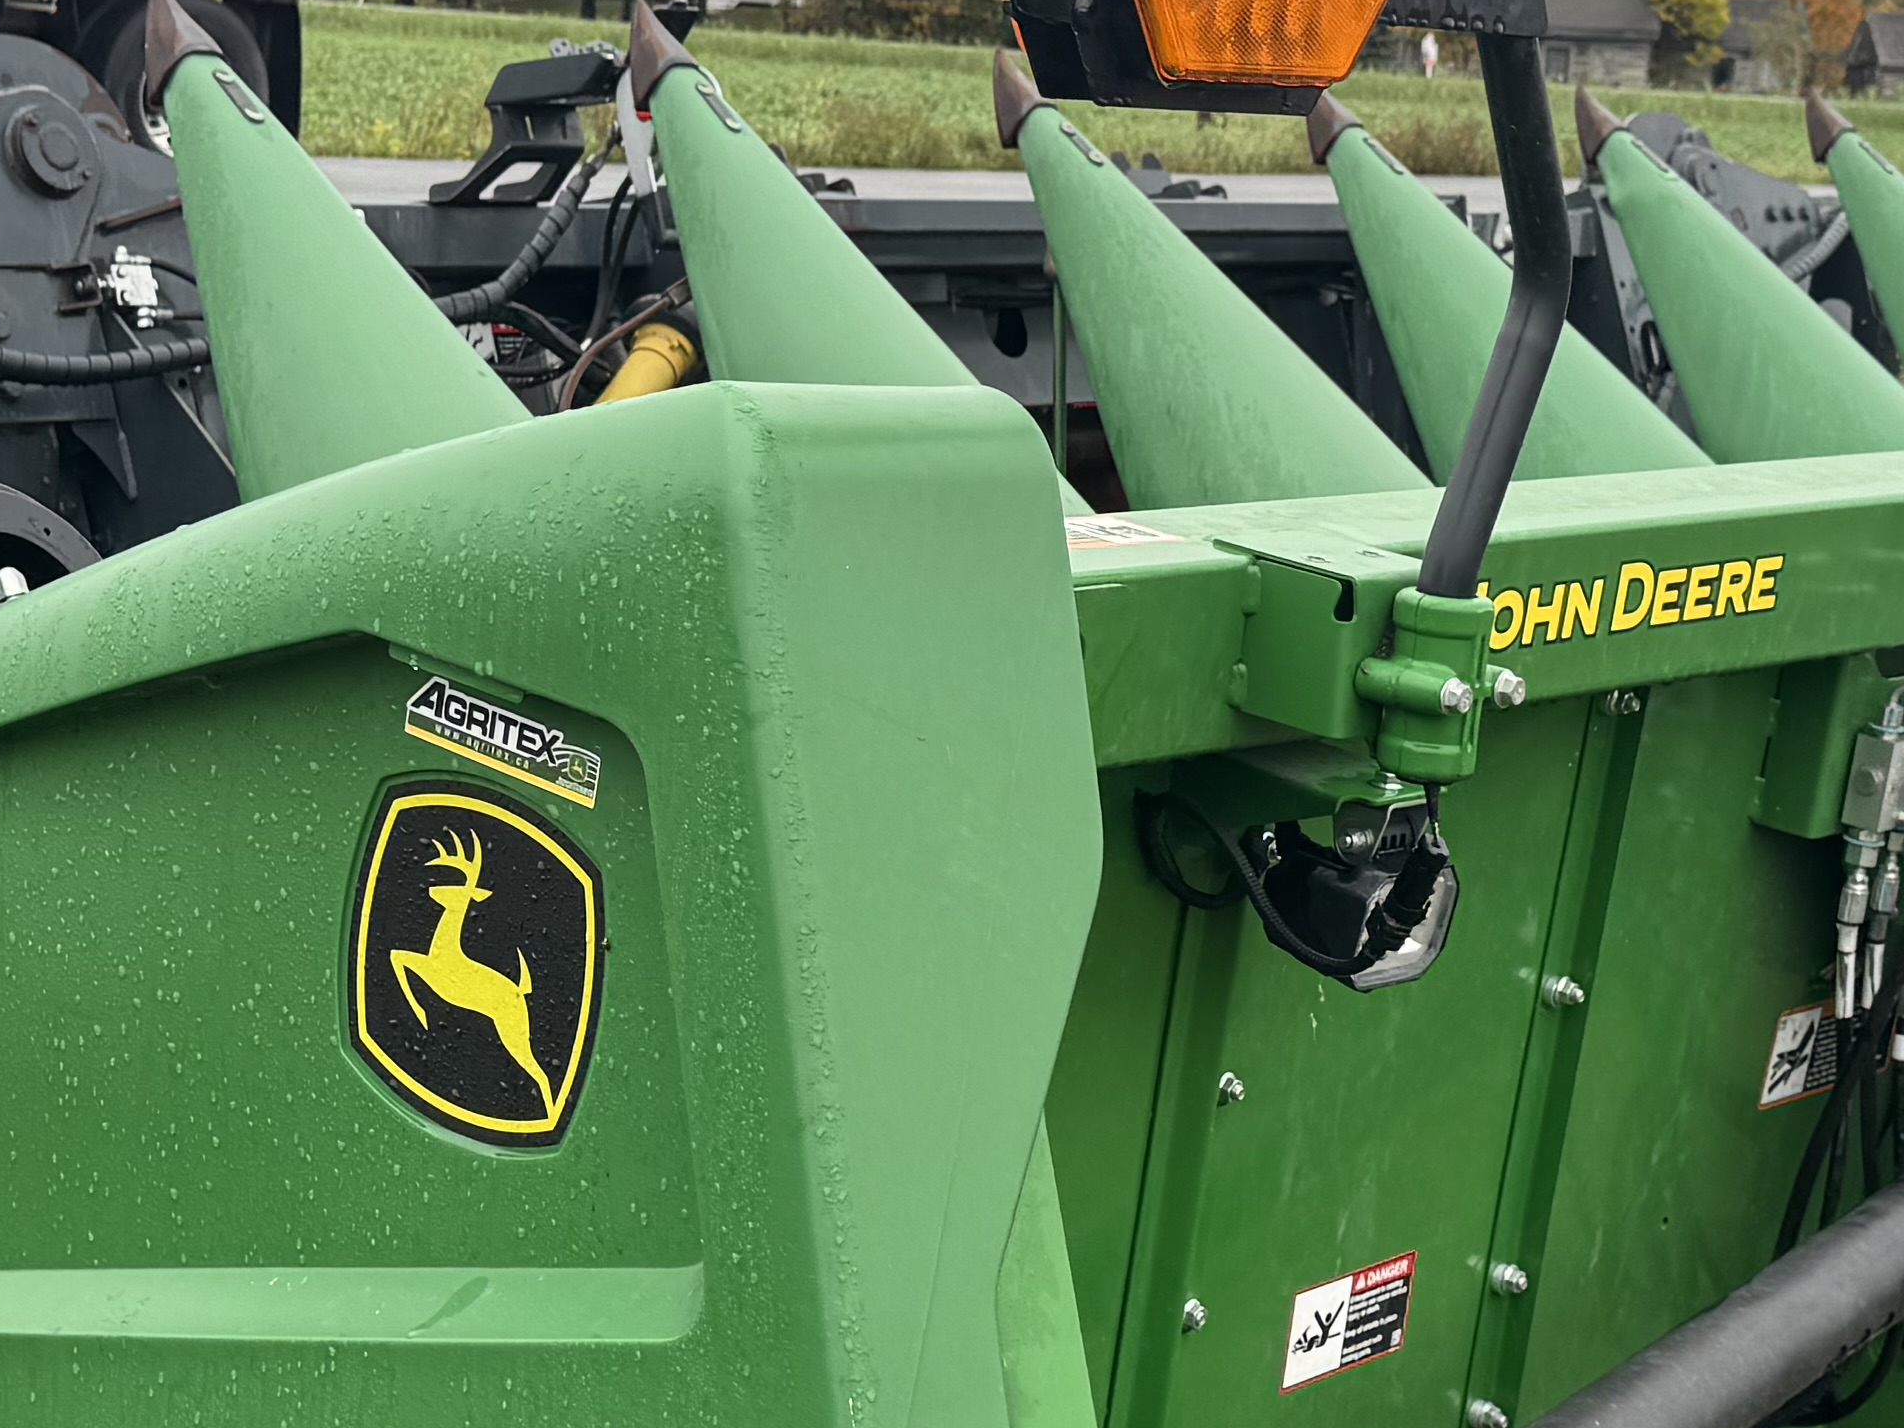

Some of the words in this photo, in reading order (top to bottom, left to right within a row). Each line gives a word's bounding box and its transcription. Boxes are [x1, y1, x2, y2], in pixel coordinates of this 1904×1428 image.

[1477, 579, 1604, 650] OHN
[1610, 555, 1784, 632] DEERE
[411, 680, 560, 766] AGRITEX
[433, 723, 531, 770] www.agritex.ca
[1366, 1258, 1409, 1286] DANGER
